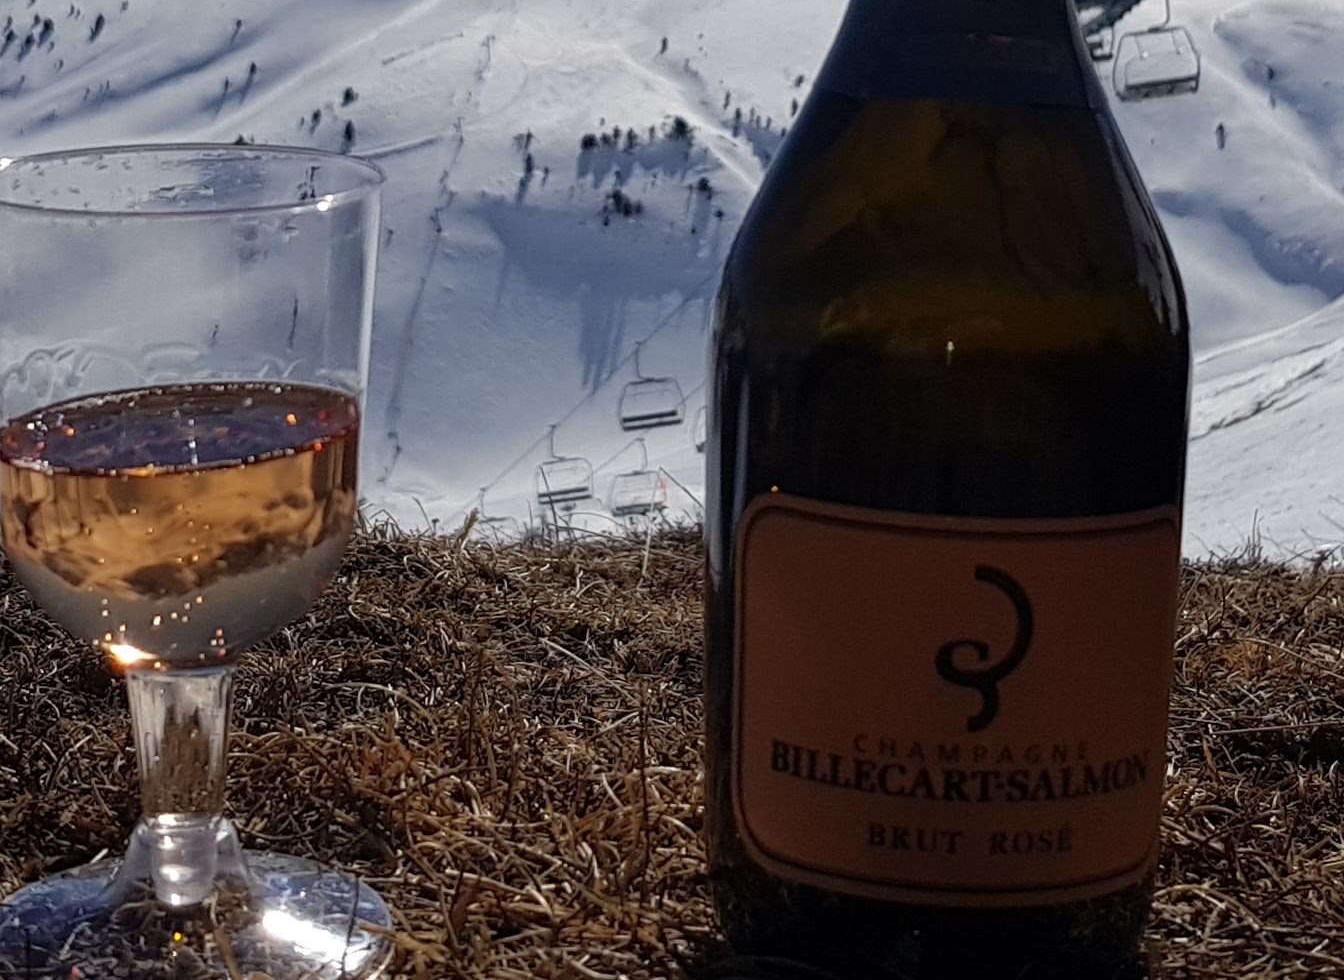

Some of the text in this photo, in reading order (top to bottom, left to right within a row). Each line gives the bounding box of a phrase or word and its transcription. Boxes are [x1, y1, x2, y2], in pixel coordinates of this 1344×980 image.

[853, 734, 1089, 765] CHAMPAGNE
[770, 739, 1150, 802] BILLECART-SALMON
[868, 821, 1073, 855] BRUT ROSÉ
